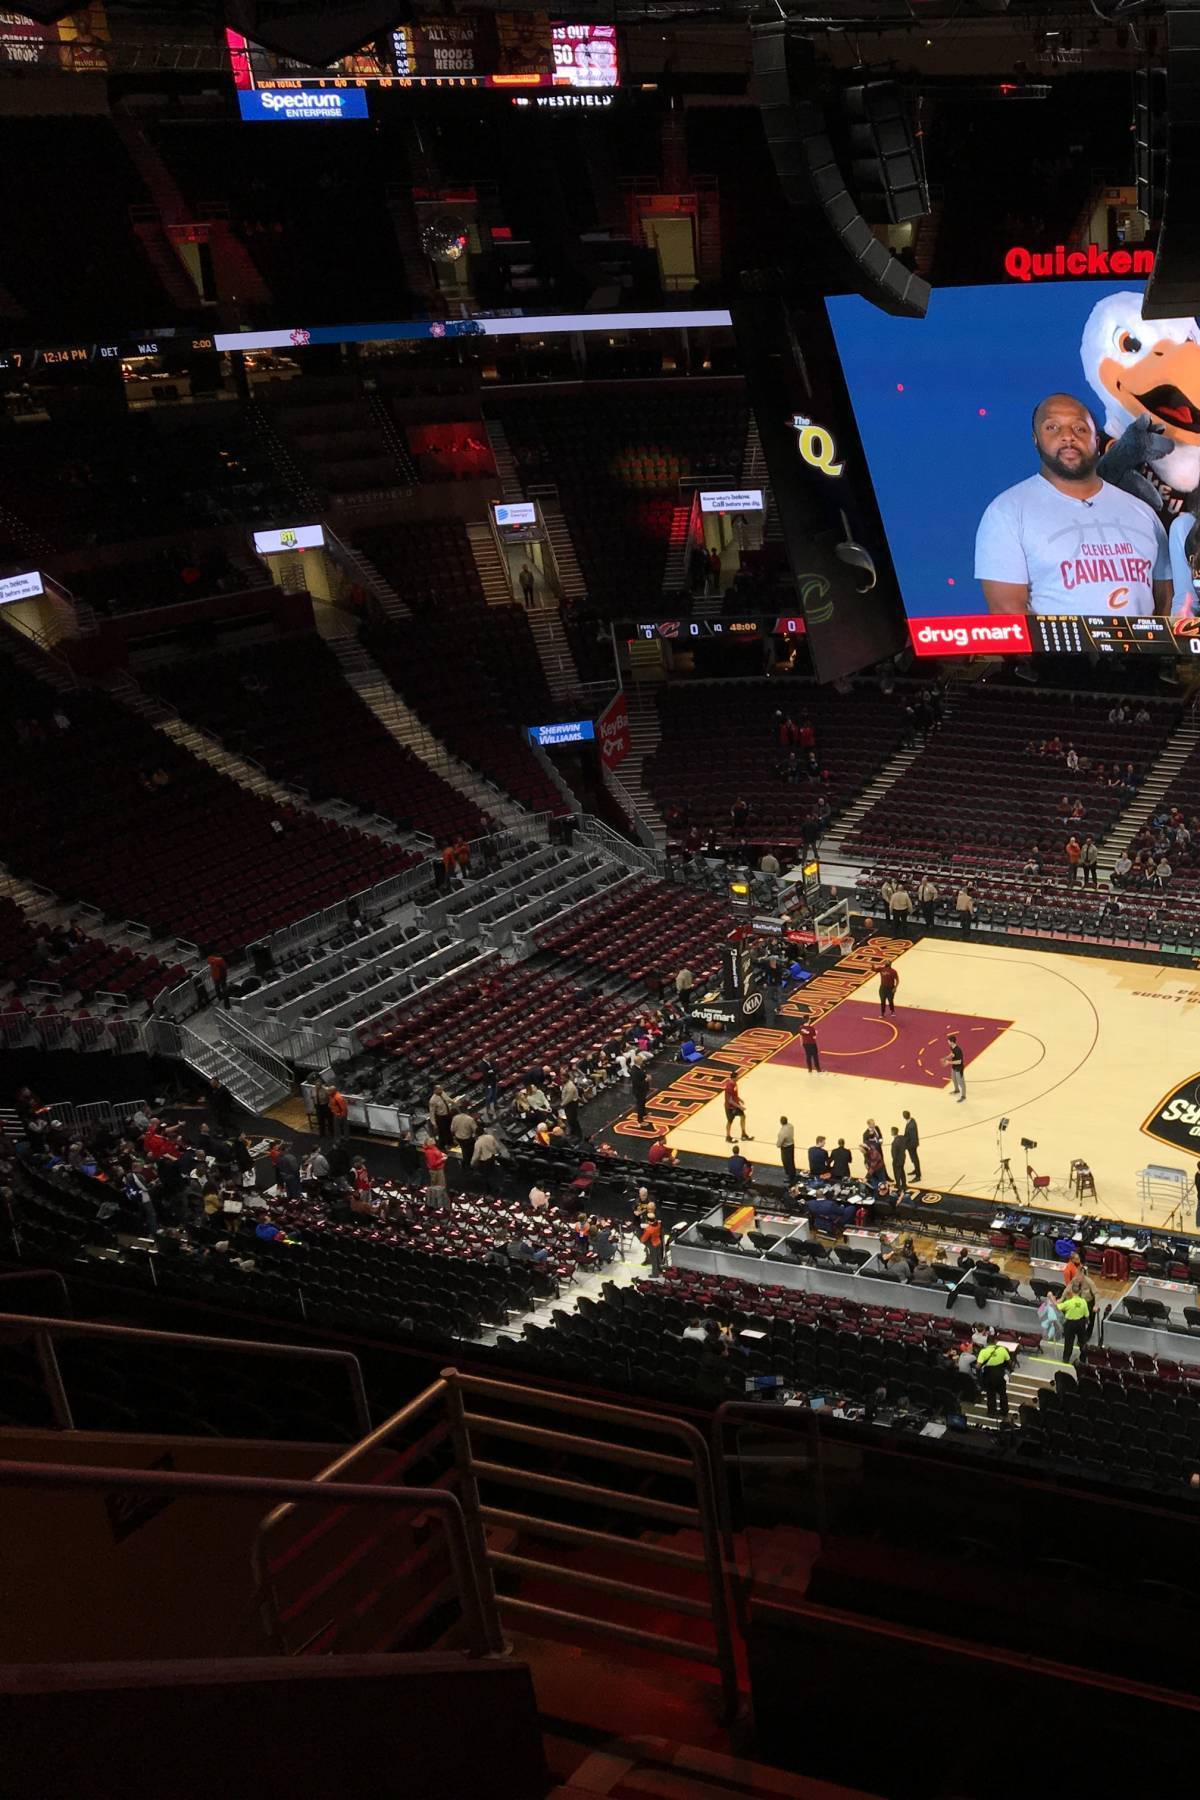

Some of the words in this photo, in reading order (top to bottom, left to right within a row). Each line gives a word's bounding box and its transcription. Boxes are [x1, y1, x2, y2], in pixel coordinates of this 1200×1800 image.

[434, 49, 473, 59] HOOD'S
[435, 59, 475, 70] HEROES
[257, 80, 279, 89] TEAM
[279, 80, 302, 89] TOTALS
[261, 92, 341, 111] Spectrum
[537, 95, 612, 106] WESTFIELD
[286, 108, 343, 118] ENTERPRISE
[1004, 246, 1154, 280] Quicken
[13, 355, 22, 367] 7
[43, 351, 69, 364] 12:14
[72, 349, 88, 361] PM
[101, 346, 119, 358] DET
[138, 343, 158, 354] WAS
[192, 339, 212, 350] 2:00
[793, 425, 843, 476] Q
[1081, 543, 1133, 557] CLEVELAND
[690, 623, 699, 635] 0
[729, 623, 757, 631] 48:00
[787, 620, 796, 632] 0
[918, 626, 969, 646] drug
[972, 624, 1023, 640] mart
[539, 724, 580, 736] SHERWIN
[780, 936, 914, 1018] CAVALIERS
[1131, 990, 1183, 1002] Loans
[745, 996, 761, 1012] KIA
[692, 1010, 712, 1022] drug
[712, 1011, 735, 1023] mart
[613, 1027, 794, 1139] CLEVELAND
